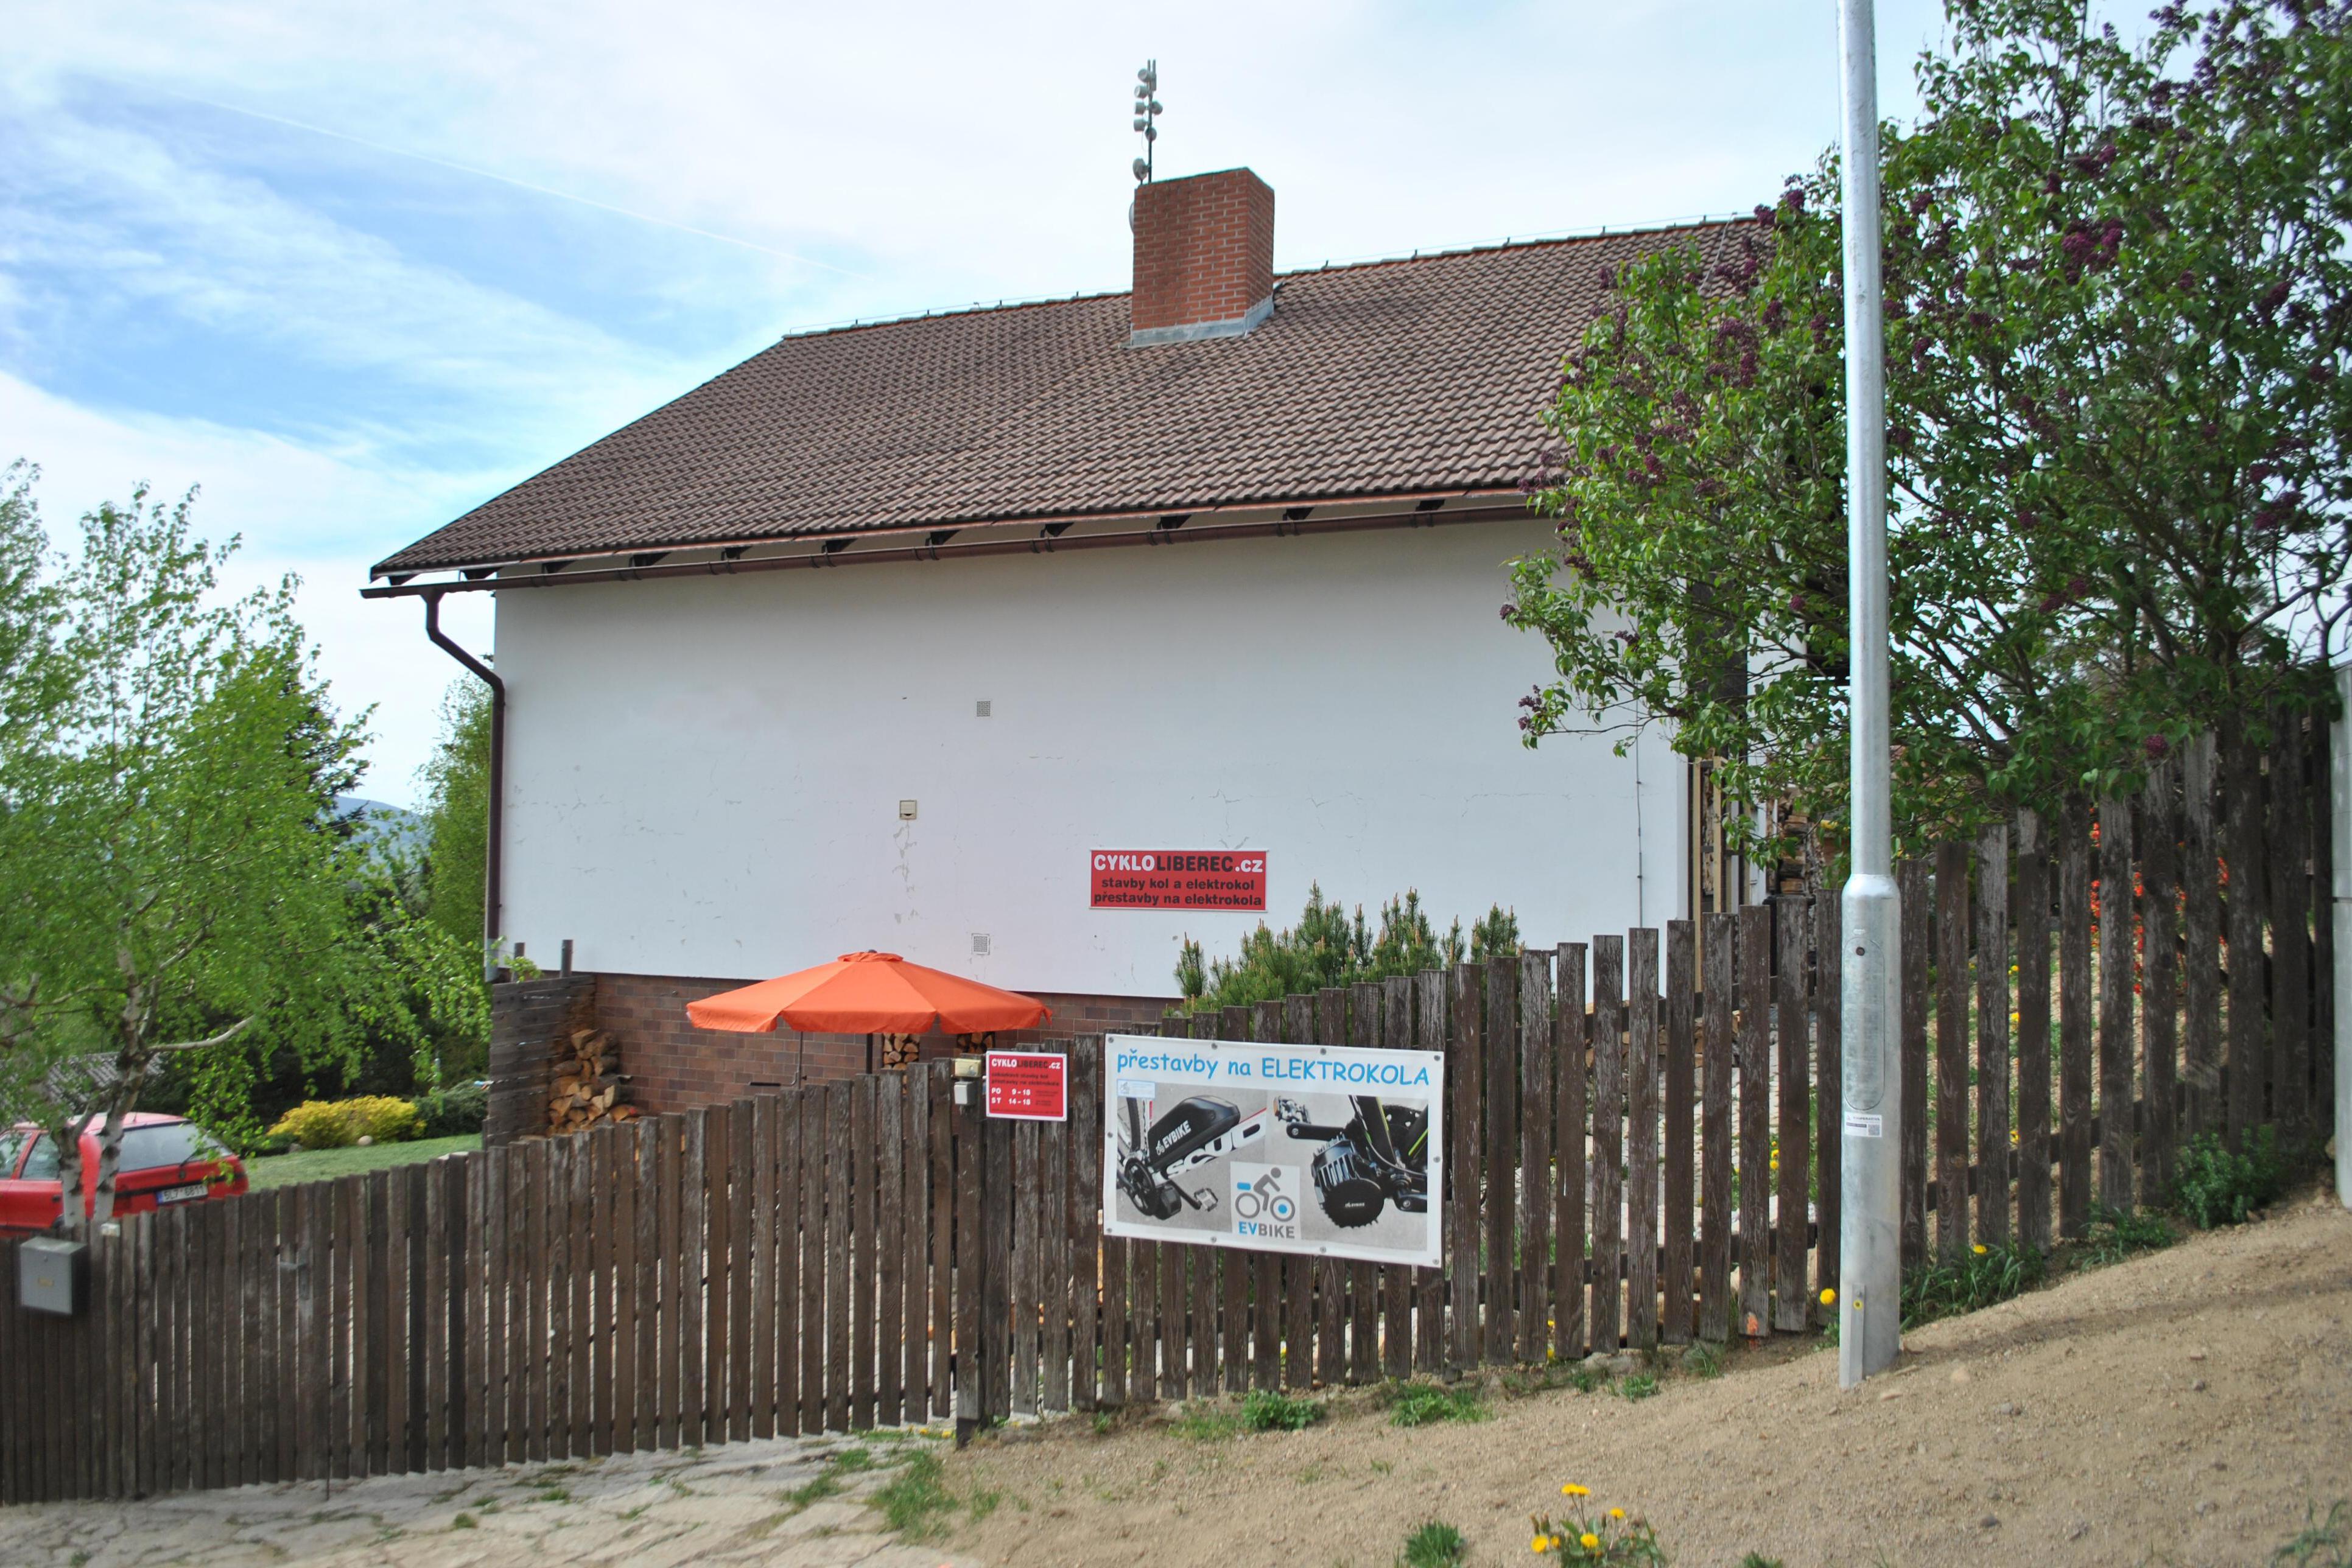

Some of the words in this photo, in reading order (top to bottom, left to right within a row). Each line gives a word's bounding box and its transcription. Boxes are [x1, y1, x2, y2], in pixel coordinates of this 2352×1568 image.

[1094, 855, 1263, 872] CYKLOLIBEREC.cz
[1101, 878, 1145, 891] stavby
[1150, 878, 1168, 889] kol
[1173, 881, 1181, 889] a
[1185, 880, 1254, 890] elektrokol
[1094, 892, 1159, 906] přestavby
[1185, 895, 1262, 906] elektrokola
[1117, 1048, 1218, 1079] přestavby
[1228, 1060, 1251, 1076] na
[1262, 1057, 1429, 1086] ELEKTROKOLA
[1162, 1120, 1192, 1149] EVBIKE
[1238, 1221, 1294, 1239] EVBIKE
